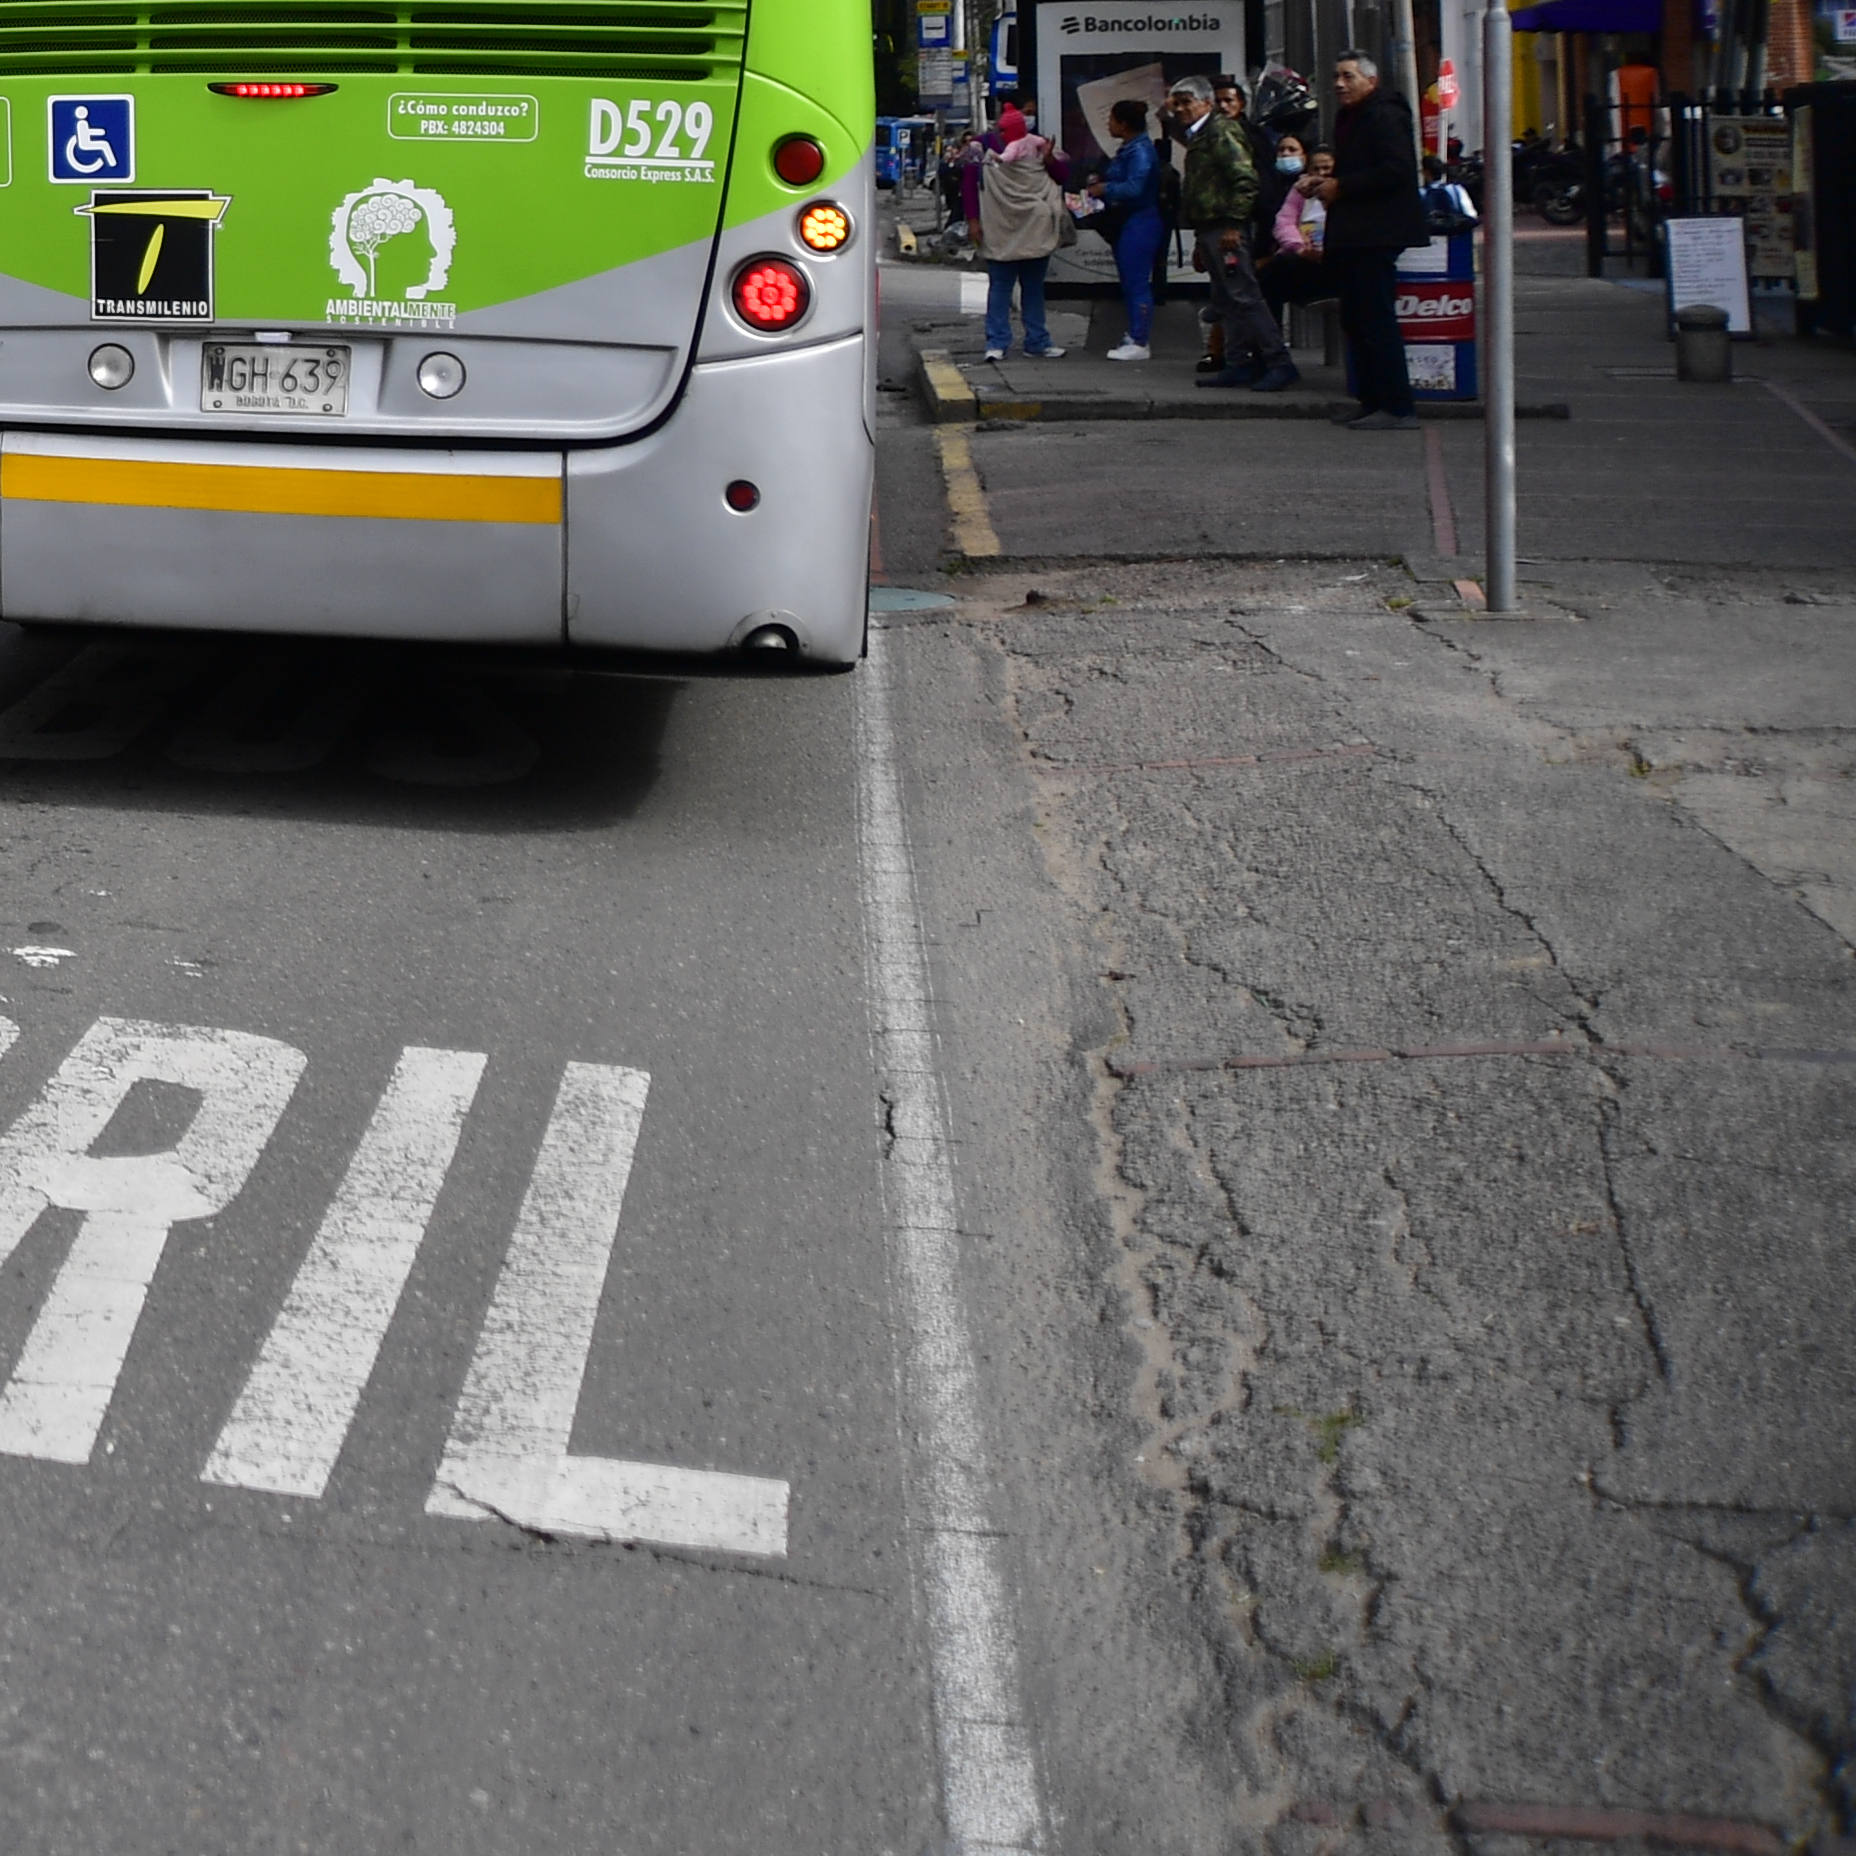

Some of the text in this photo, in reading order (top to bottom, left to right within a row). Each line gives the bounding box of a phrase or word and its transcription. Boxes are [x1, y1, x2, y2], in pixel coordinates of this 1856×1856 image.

[1084, 13, 1221, 33] Bancolombia
[398, 99, 529, 117] ¿Cómo conduzco?
[420, 120, 505, 136] PBX: 4824304
[589, 97, 713, 159] D529
[584, 164, 715, 183] Consorcio Express S.A.S.
[96, 298, 208, 317] TRANSMILENIO
[326, 299, 456, 319] AMBIENTALMENTE
[326, 315, 456, 330] SOSTENIBLE
[208, 354, 346, 396] WGH 639
[236, 395, 281, 409] BOGOTA
